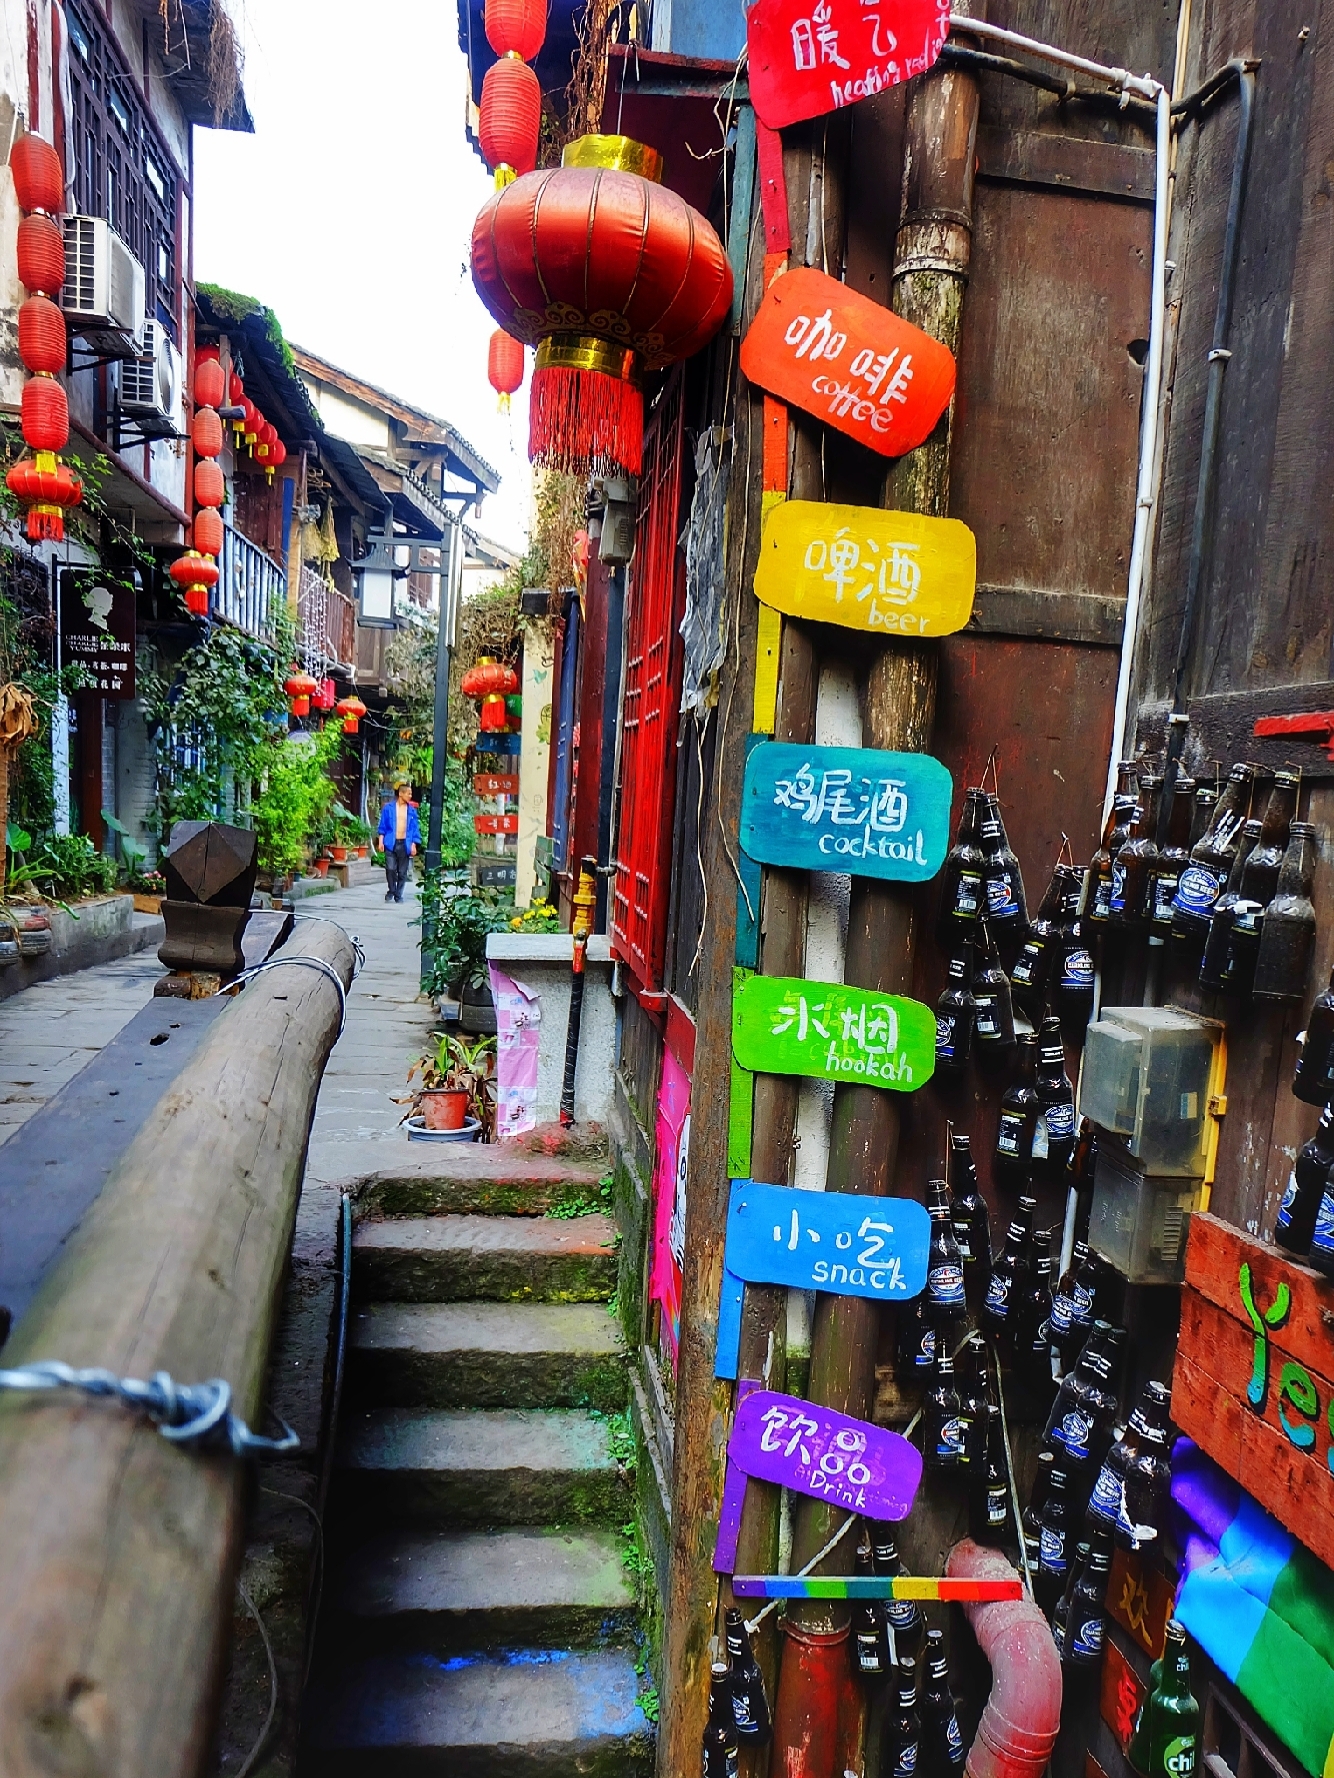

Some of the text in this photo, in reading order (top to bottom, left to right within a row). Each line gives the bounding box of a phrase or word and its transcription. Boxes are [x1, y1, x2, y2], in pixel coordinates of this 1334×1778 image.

[784, 308, 913, 405] 咖啡
[811, 374, 893, 433] coffee
[804, 526, 921, 606] 啤酒
[867, 597, 930, 634] beer
[773, 763, 907, 832] 鸡尾酒
[818, 824, 928, 866] cocktail
[771, 996, 898, 1054] 水烟
[825, 1040, 913, 1083] hookah
[773, 1209, 896, 1269] 小吃
[811, 1257, 906, 1290] snack
[1239, 1262, 1334, 1478] Ye
[760, 1406, 871, 1485] 饮品
[809, 1469, 866, 1509] Drink
